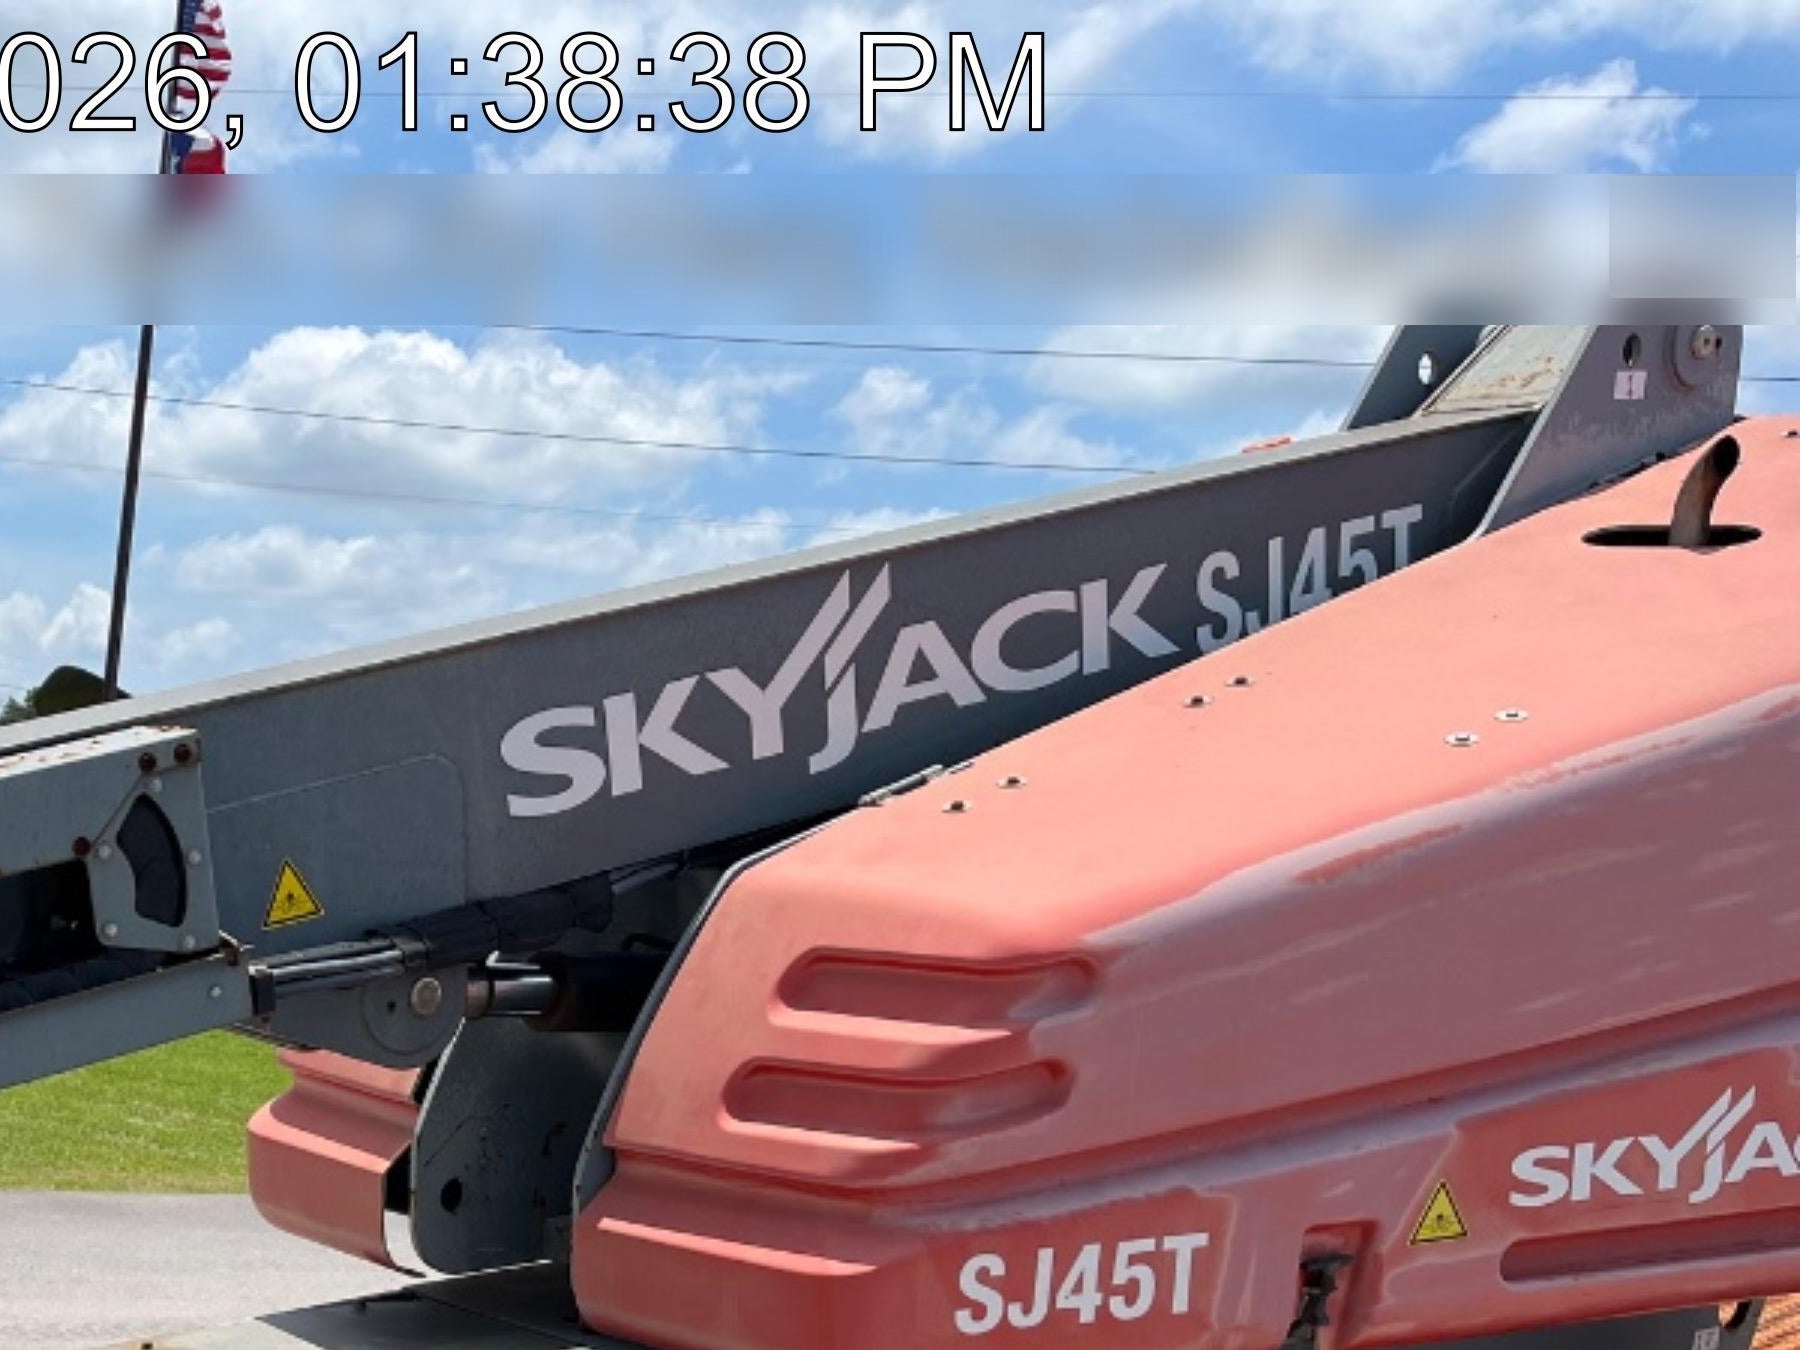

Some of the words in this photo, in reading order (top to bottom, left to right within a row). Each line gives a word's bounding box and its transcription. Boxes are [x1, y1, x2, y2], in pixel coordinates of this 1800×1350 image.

[500, 562, 1180, 817] SKYJACK
[1196, 503, 1423, 655] SJ45T
[1508, 1085, 1800, 1207] SKYJA
[954, 1232, 1210, 1335] SJ45T
